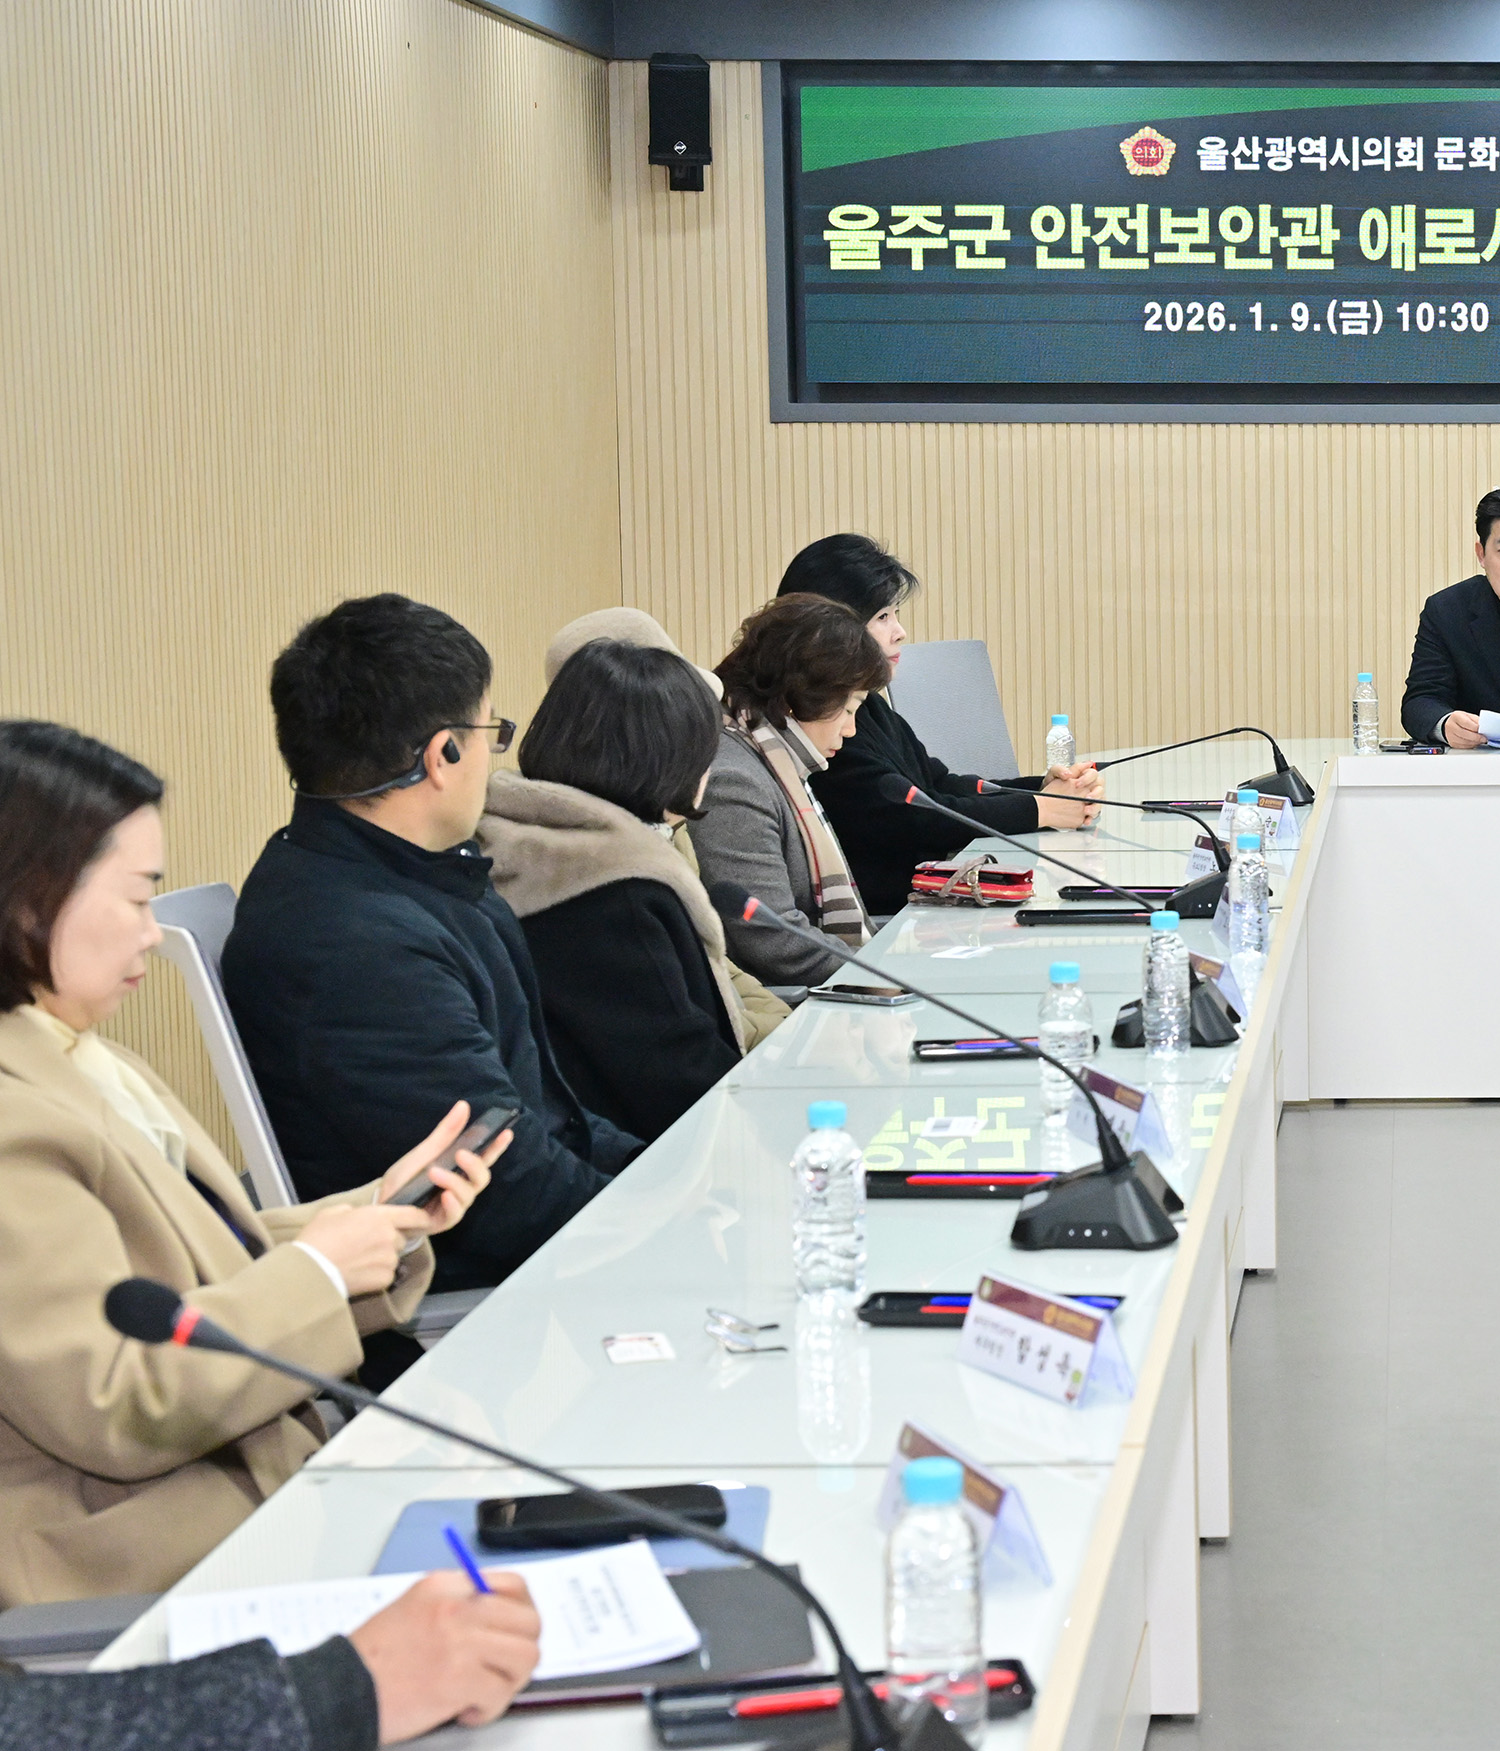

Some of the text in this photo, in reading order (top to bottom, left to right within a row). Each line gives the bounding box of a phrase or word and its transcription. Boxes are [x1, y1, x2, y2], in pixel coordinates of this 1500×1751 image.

[1133, 145, 1162, 159] 의회
[1196, 135, 1424, 172] 울산광역시의회
[822, 204, 1011, 271] 울주군
[1030, 203, 1341, 271] 안전보안관
[1144, 301, 1237, 332] 2026.
[1396, 301, 1489, 333] 10:30
